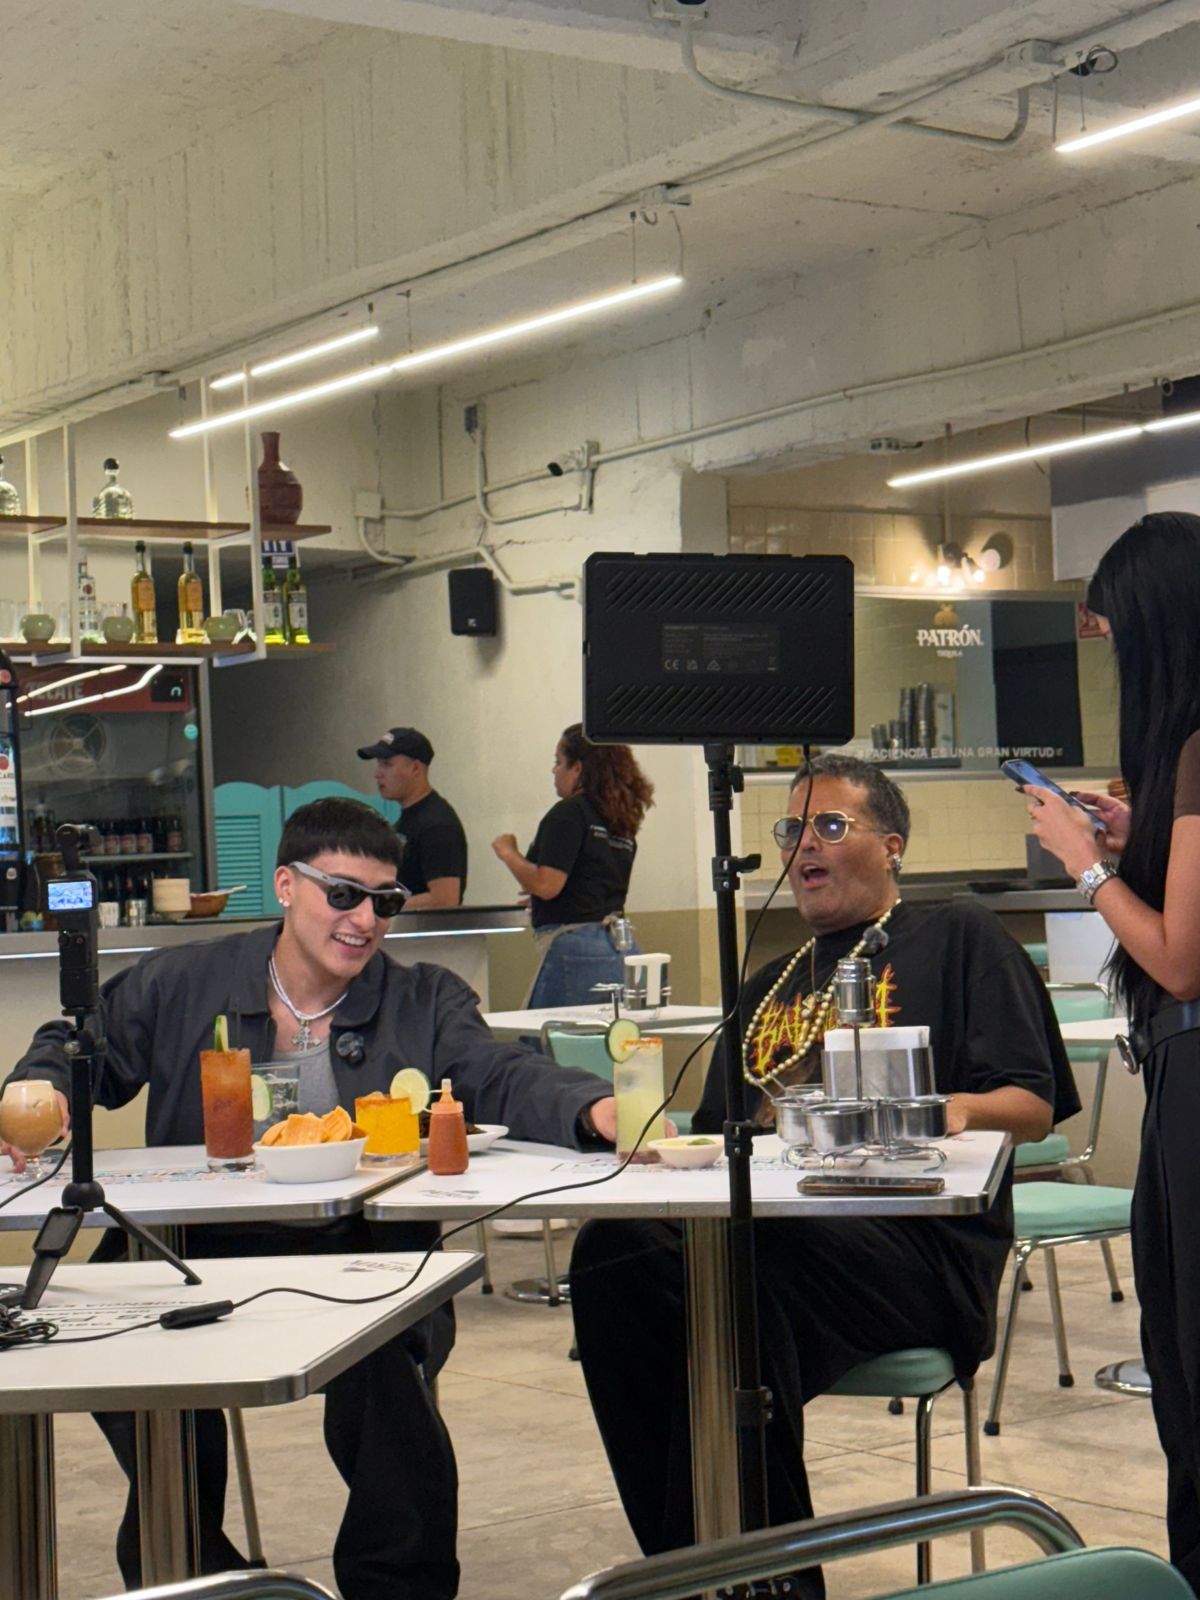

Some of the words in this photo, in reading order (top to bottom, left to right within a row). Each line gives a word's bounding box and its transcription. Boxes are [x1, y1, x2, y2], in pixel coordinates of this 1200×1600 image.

[916, 624, 983, 647] PATRÓN
[931, 747, 945, 759] ES
[950, 747, 974, 759] UNA
[976, 746, 1010, 758] GRAN
[1012, 746, 1055, 758] VIRTUD
